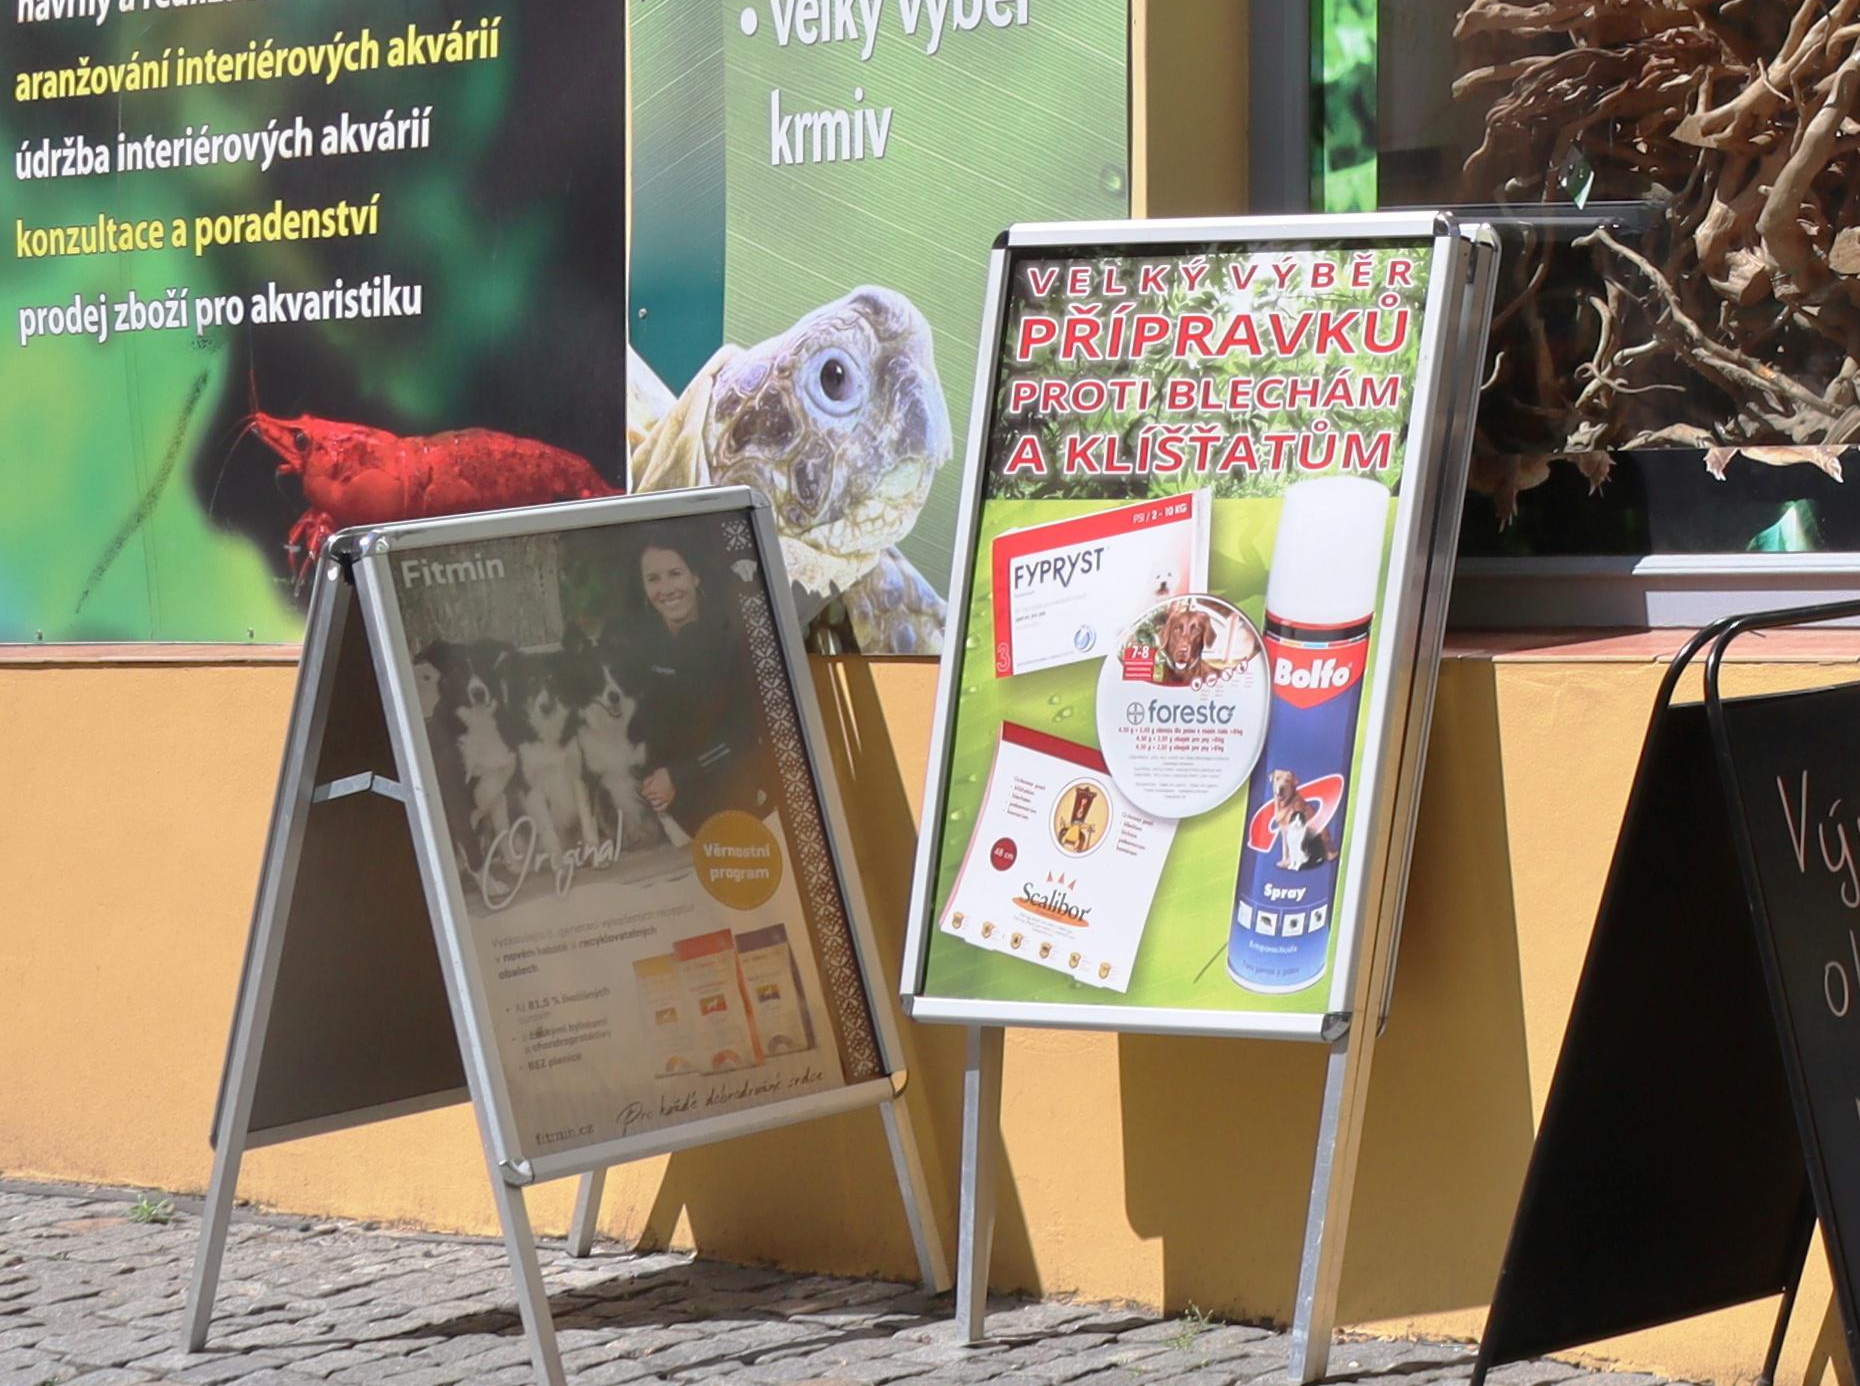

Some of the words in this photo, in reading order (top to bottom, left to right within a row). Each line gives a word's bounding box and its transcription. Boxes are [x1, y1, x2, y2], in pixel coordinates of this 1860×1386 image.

[15, 51, 170, 102] aranžování
[177, 29, 380, 85] interiérových
[386, 17, 502, 69] akvárií
[15, 133, 110, 180] údržba
[116, 113, 314, 172] interiérových
[320, 106, 433, 156] akvárií
[770, 87, 893, 166] krmiv
[16, 213, 164, 259] konzultace
[171, 220, 187, 248] a
[194, 193, 381, 257] poradenství
[1028, 257, 1210, 297] VELKÝ
[1231, 254, 1414, 291] VÝBĚR
[19, 295, 108, 346] prodej
[114, 288, 188, 332] zboží
[195, 295, 245, 336] pro
[250, 275, 423, 325] akvaristiku
[1016, 292, 1410, 362] PŘÍPRAVKŮ
[1010, 379, 1153, 414] PROTI
[1165, 369, 1401, 412] BLECHÁM
[1004, 434, 1048, 475] A
[1063, 419, 1393, 475] KLÍŠŤATŮM
[401, 552, 506, 591] Fitmin
[1014, 546, 1105, 589] FYPRYST
[997, 642, 1011, 673] 3
[1274, 657, 1351, 690] Bolfo
[1148, 698, 1237, 726] foresto
[481, 808, 625, 911] Original
[709, 867, 771, 883] program
[1023, 882, 1092, 922] Scalibor
[1263, 883, 1306, 902] Spray
